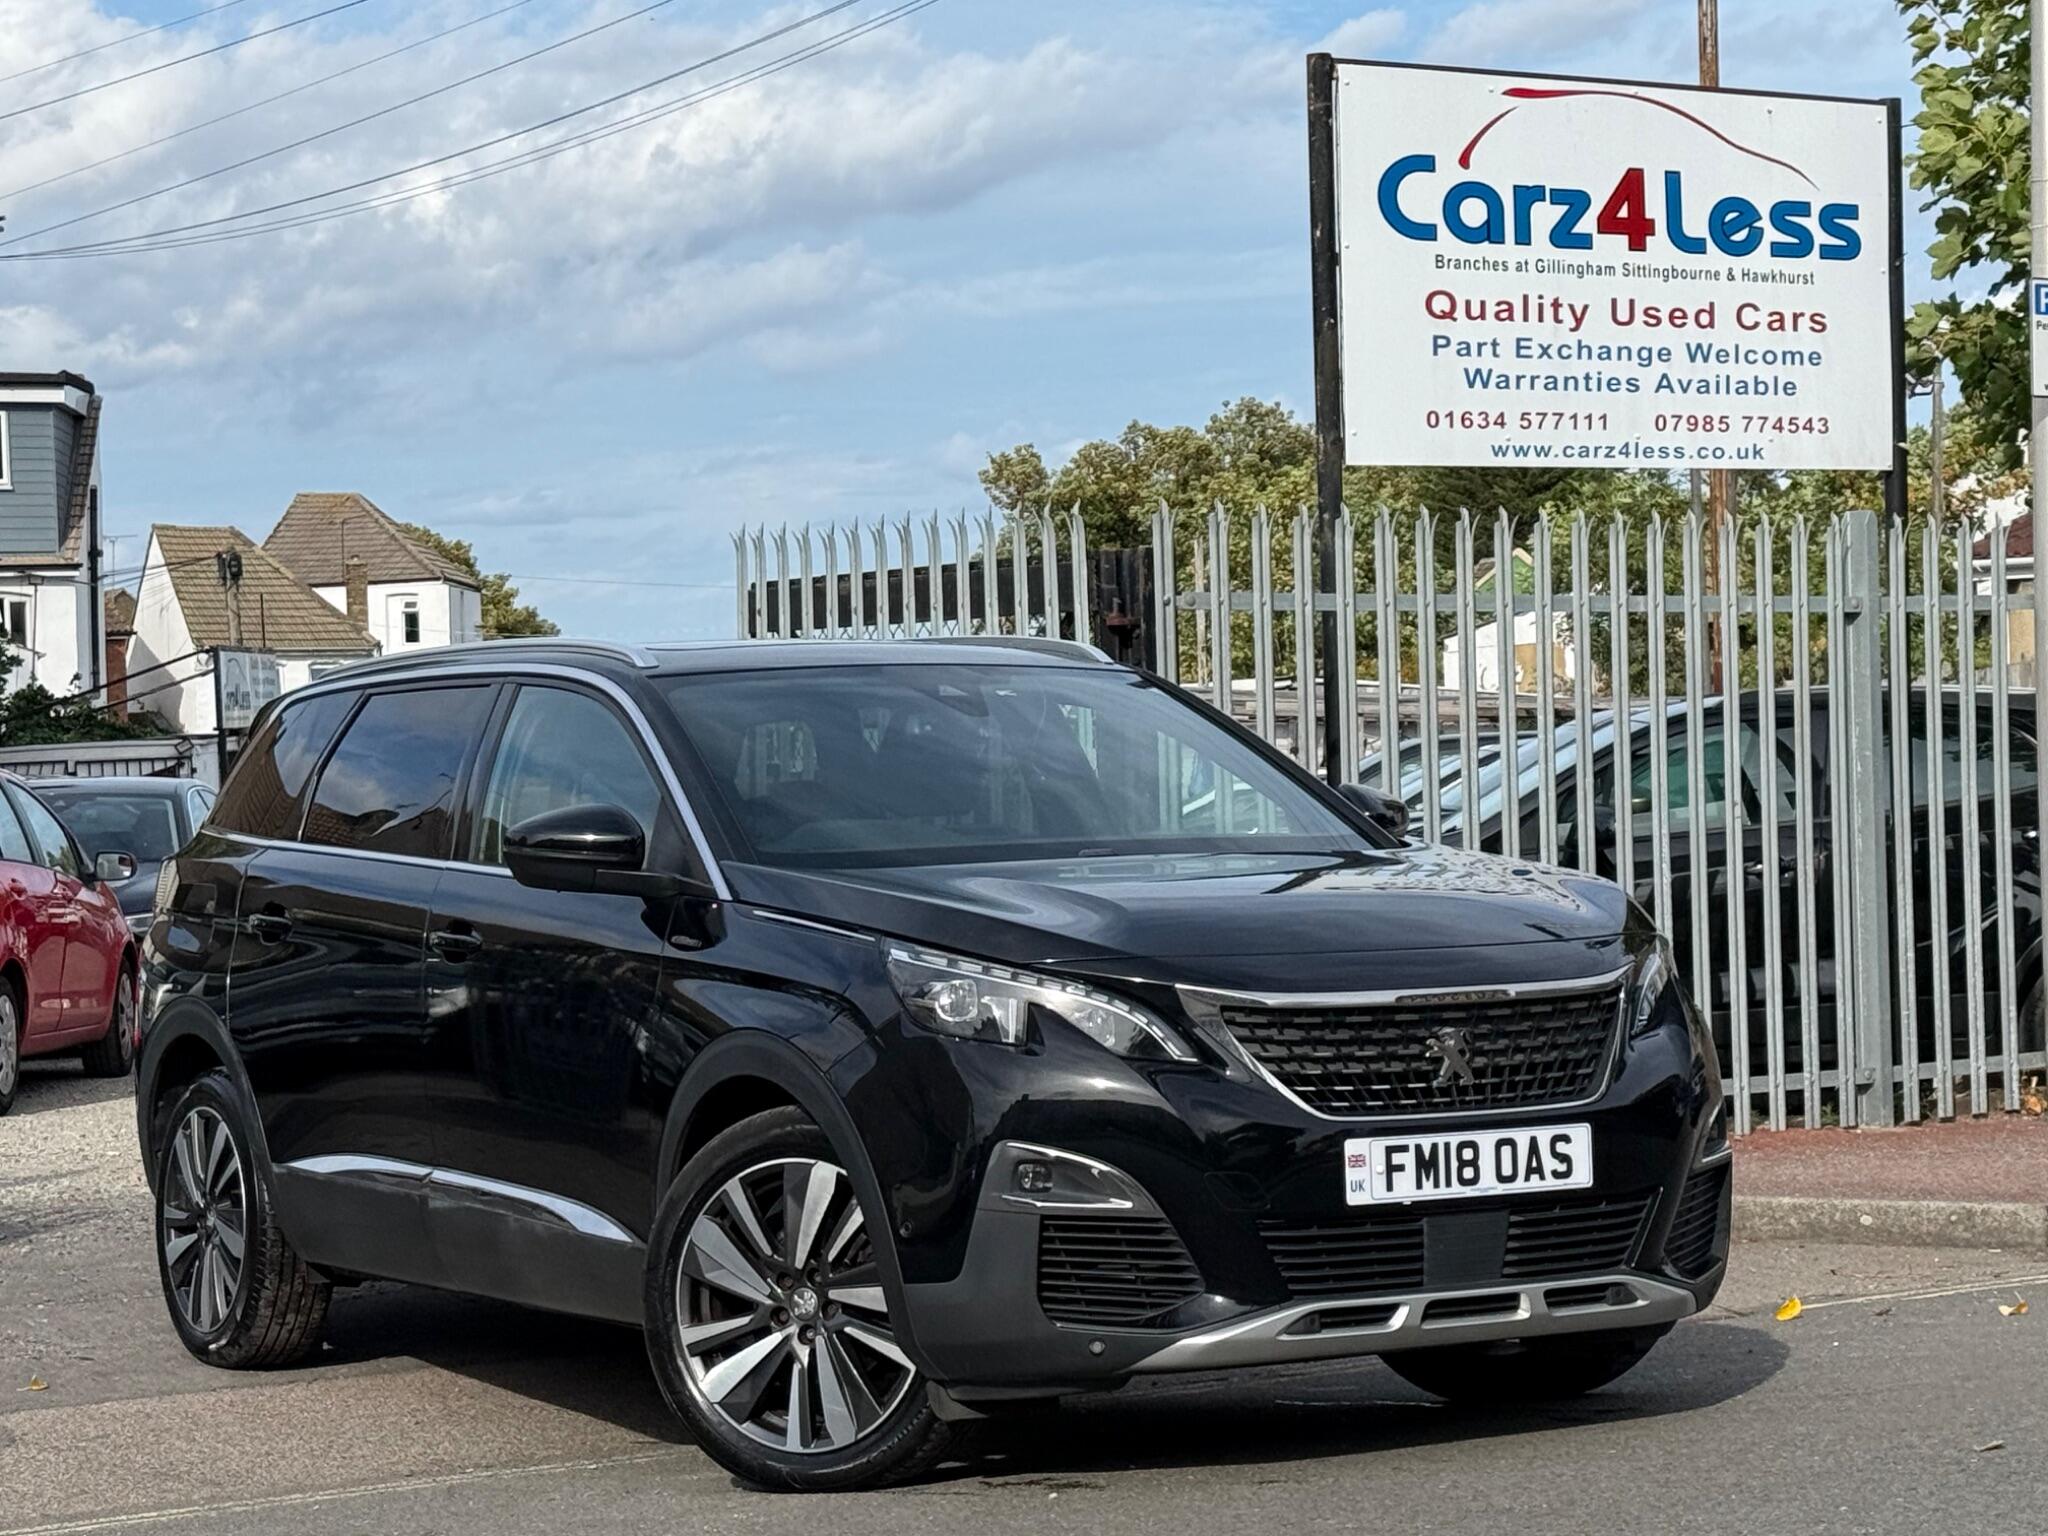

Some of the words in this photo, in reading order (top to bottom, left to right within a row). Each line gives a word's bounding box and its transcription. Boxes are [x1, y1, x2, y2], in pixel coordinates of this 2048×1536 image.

[1376, 153, 1863, 262] Carz4Less
[1434, 253, 1509, 272] Branches
[1515, 258, 1529, 273] at
[1534, 258, 1616, 280] Gillingham
[1622, 262, 1721, 283] Sittingbourne
[1726, 267, 1736, 282] &
[1741, 267, 1815, 286] Hawkhurst
[1424, 289, 1590, 333] Quality
[1610, 297, 1716, 330] Used
[1735, 302, 1828, 334] Cars
[1432, 334, 1501, 359] Part
[1515, 336, 1672, 366] Exchange
[1685, 342, 1822, 367] Welcome
[1463, 367, 1641, 394] Warranties
[1654, 372, 1798, 397] Available
[1426, 410, 1507, 430] 01634
[1519, 411, 1608, 431] 577111
[1654, 414, 1730, 433] 07985
[1741, 415, 1829, 435] 774543
[1490, 441, 1765, 460] www.carz4less.co.uk
[1385, 1140, 1480, 1192] FM18
[1495, 1134, 1573, 1183] OAS
[1350, 1179, 1365, 1193] UK
